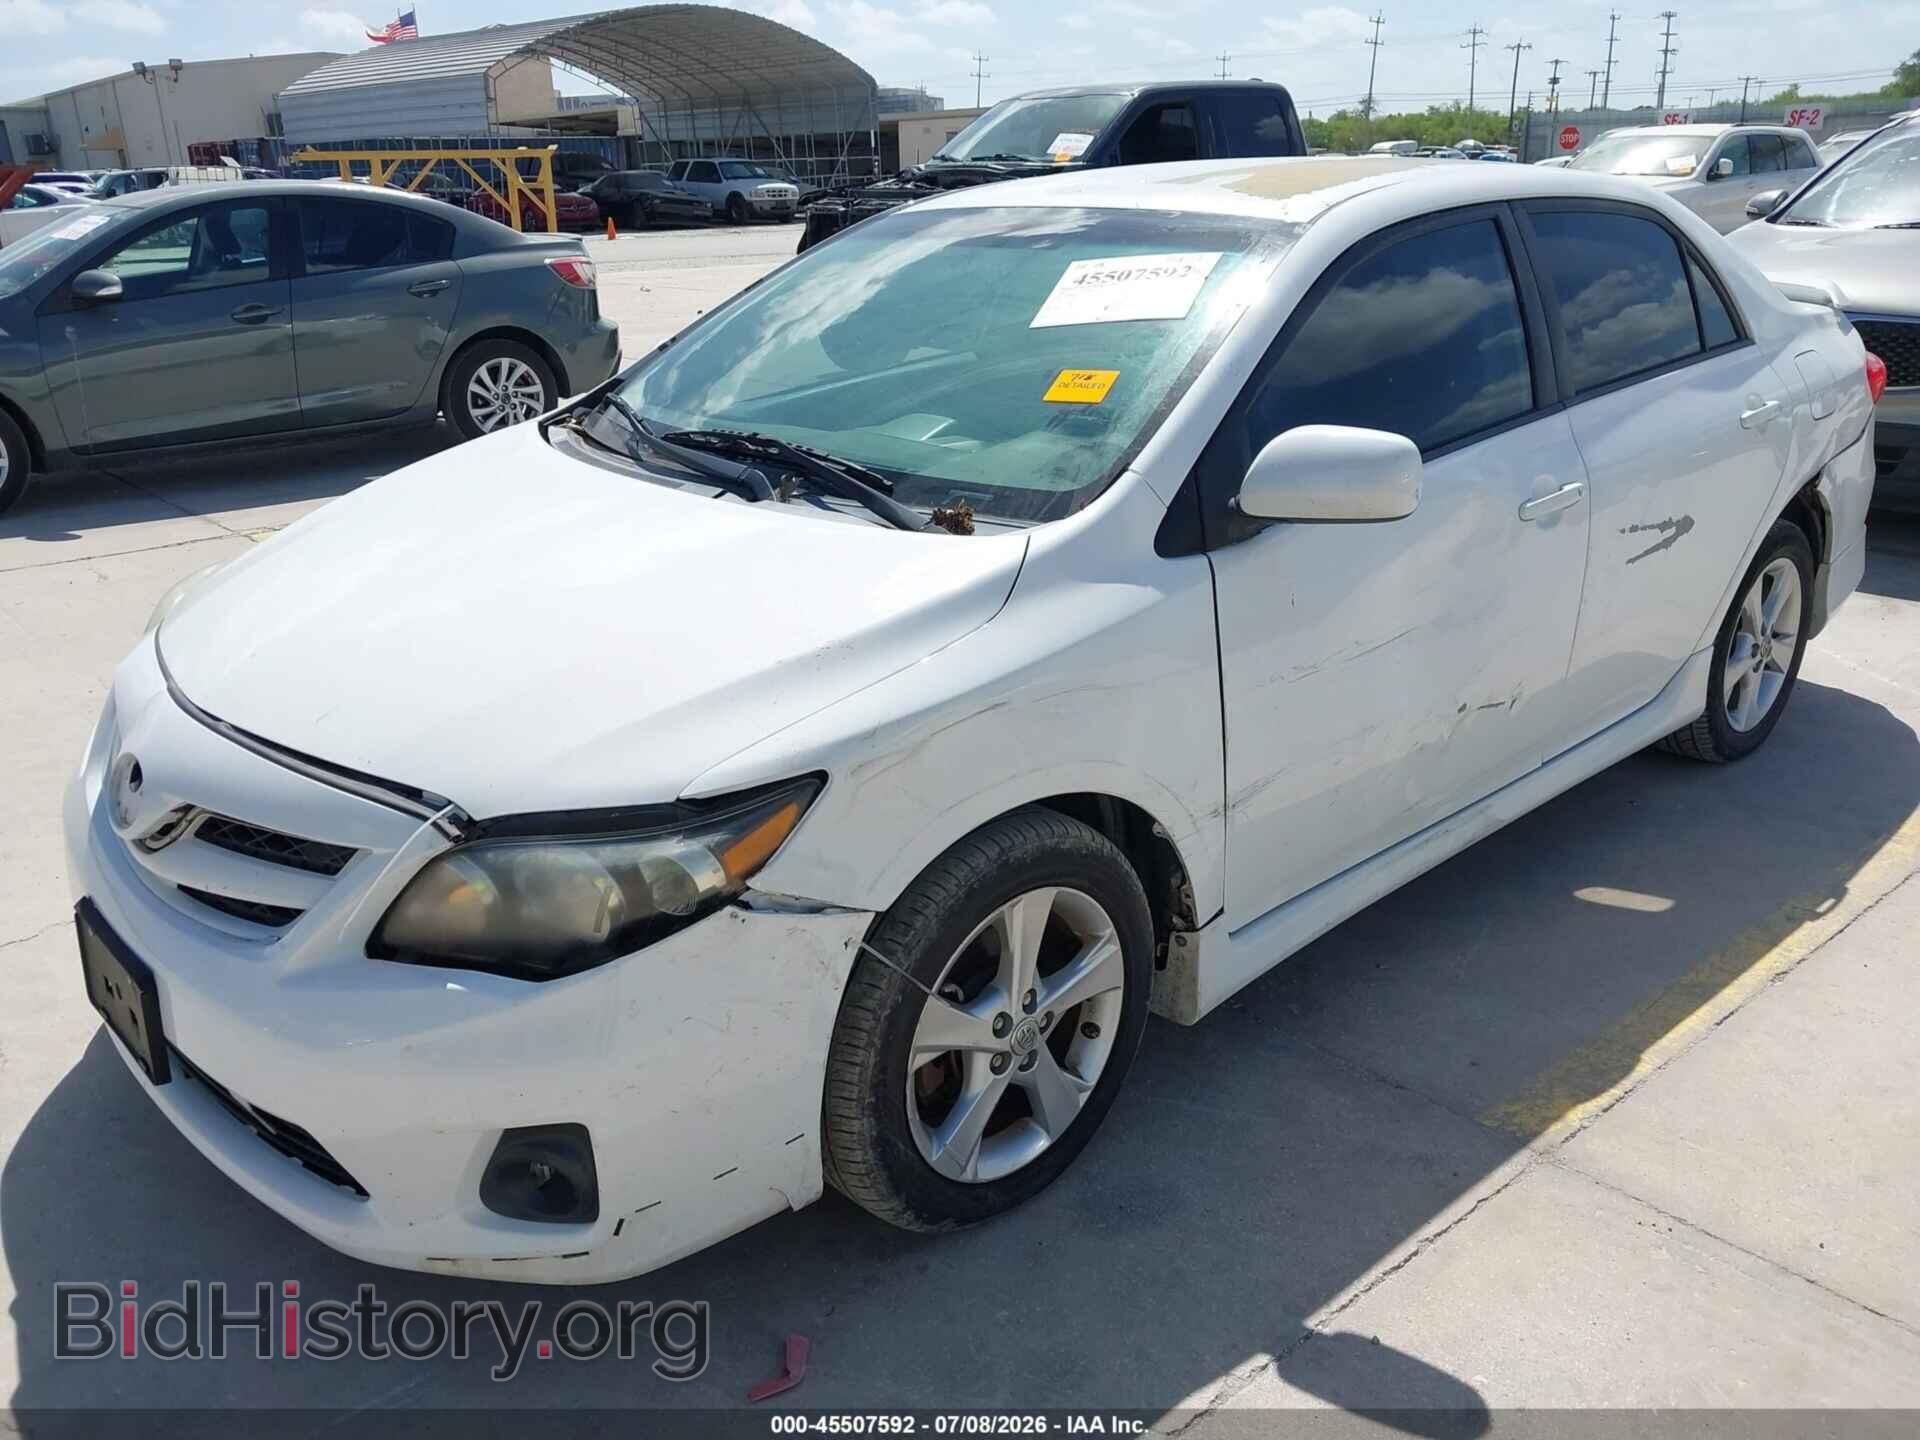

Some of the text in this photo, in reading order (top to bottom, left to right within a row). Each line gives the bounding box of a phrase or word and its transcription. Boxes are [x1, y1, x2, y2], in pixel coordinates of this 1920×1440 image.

[1787, 108, 1821, 128] SF-2
[1560, 133, 1579, 145] STOP
[1073, 264, 1192, 286] 45507592
